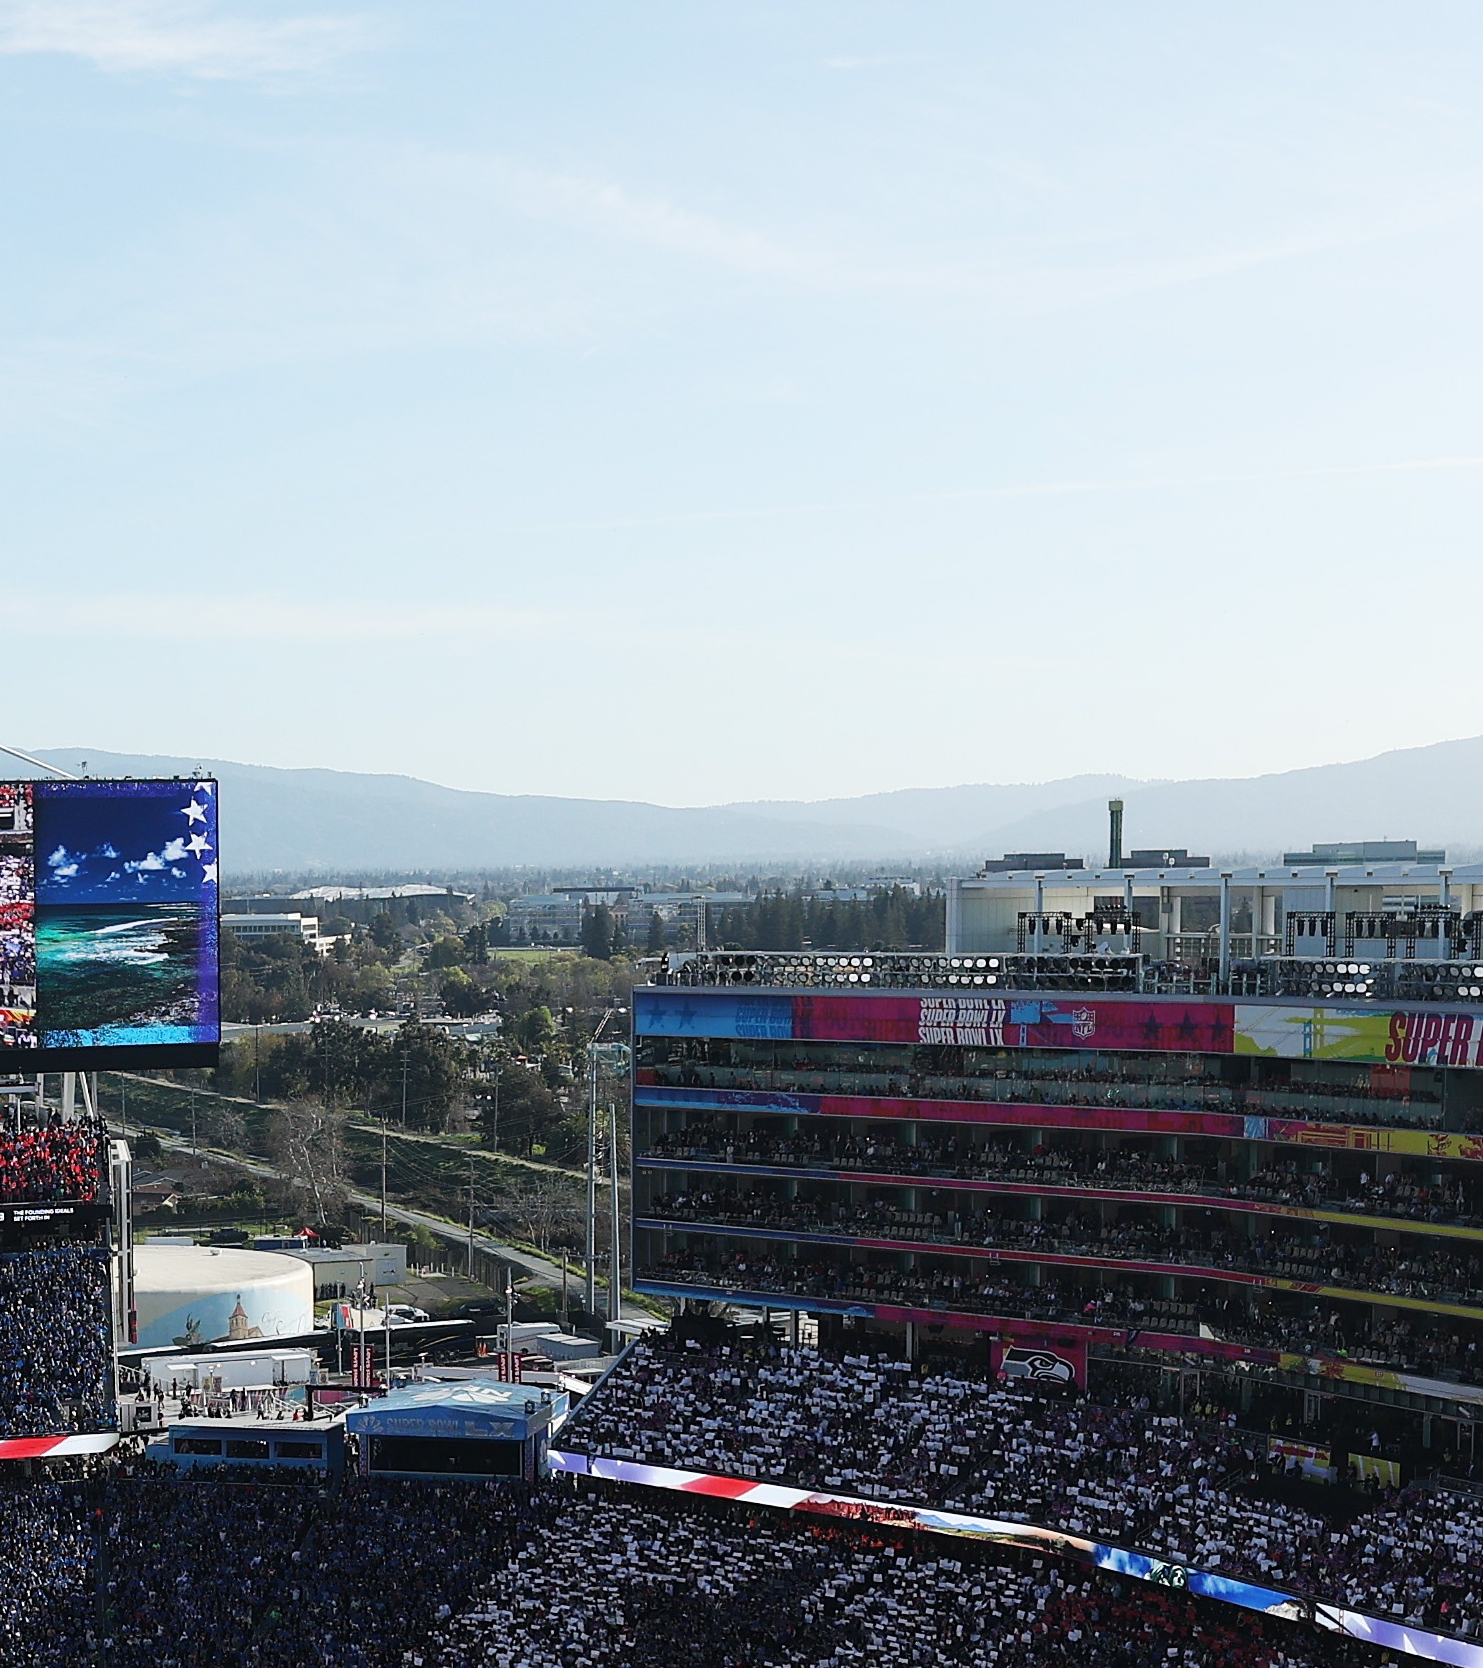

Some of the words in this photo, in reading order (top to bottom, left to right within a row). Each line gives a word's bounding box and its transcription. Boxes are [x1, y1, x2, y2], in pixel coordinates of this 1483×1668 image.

[919, 1009, 956, 1026] SUPER
[956, 1009, 988, 1028] BOWL
[1386, 1011, 1474, 1066] SUPER
[465, 1420, 517, 1437] LX
